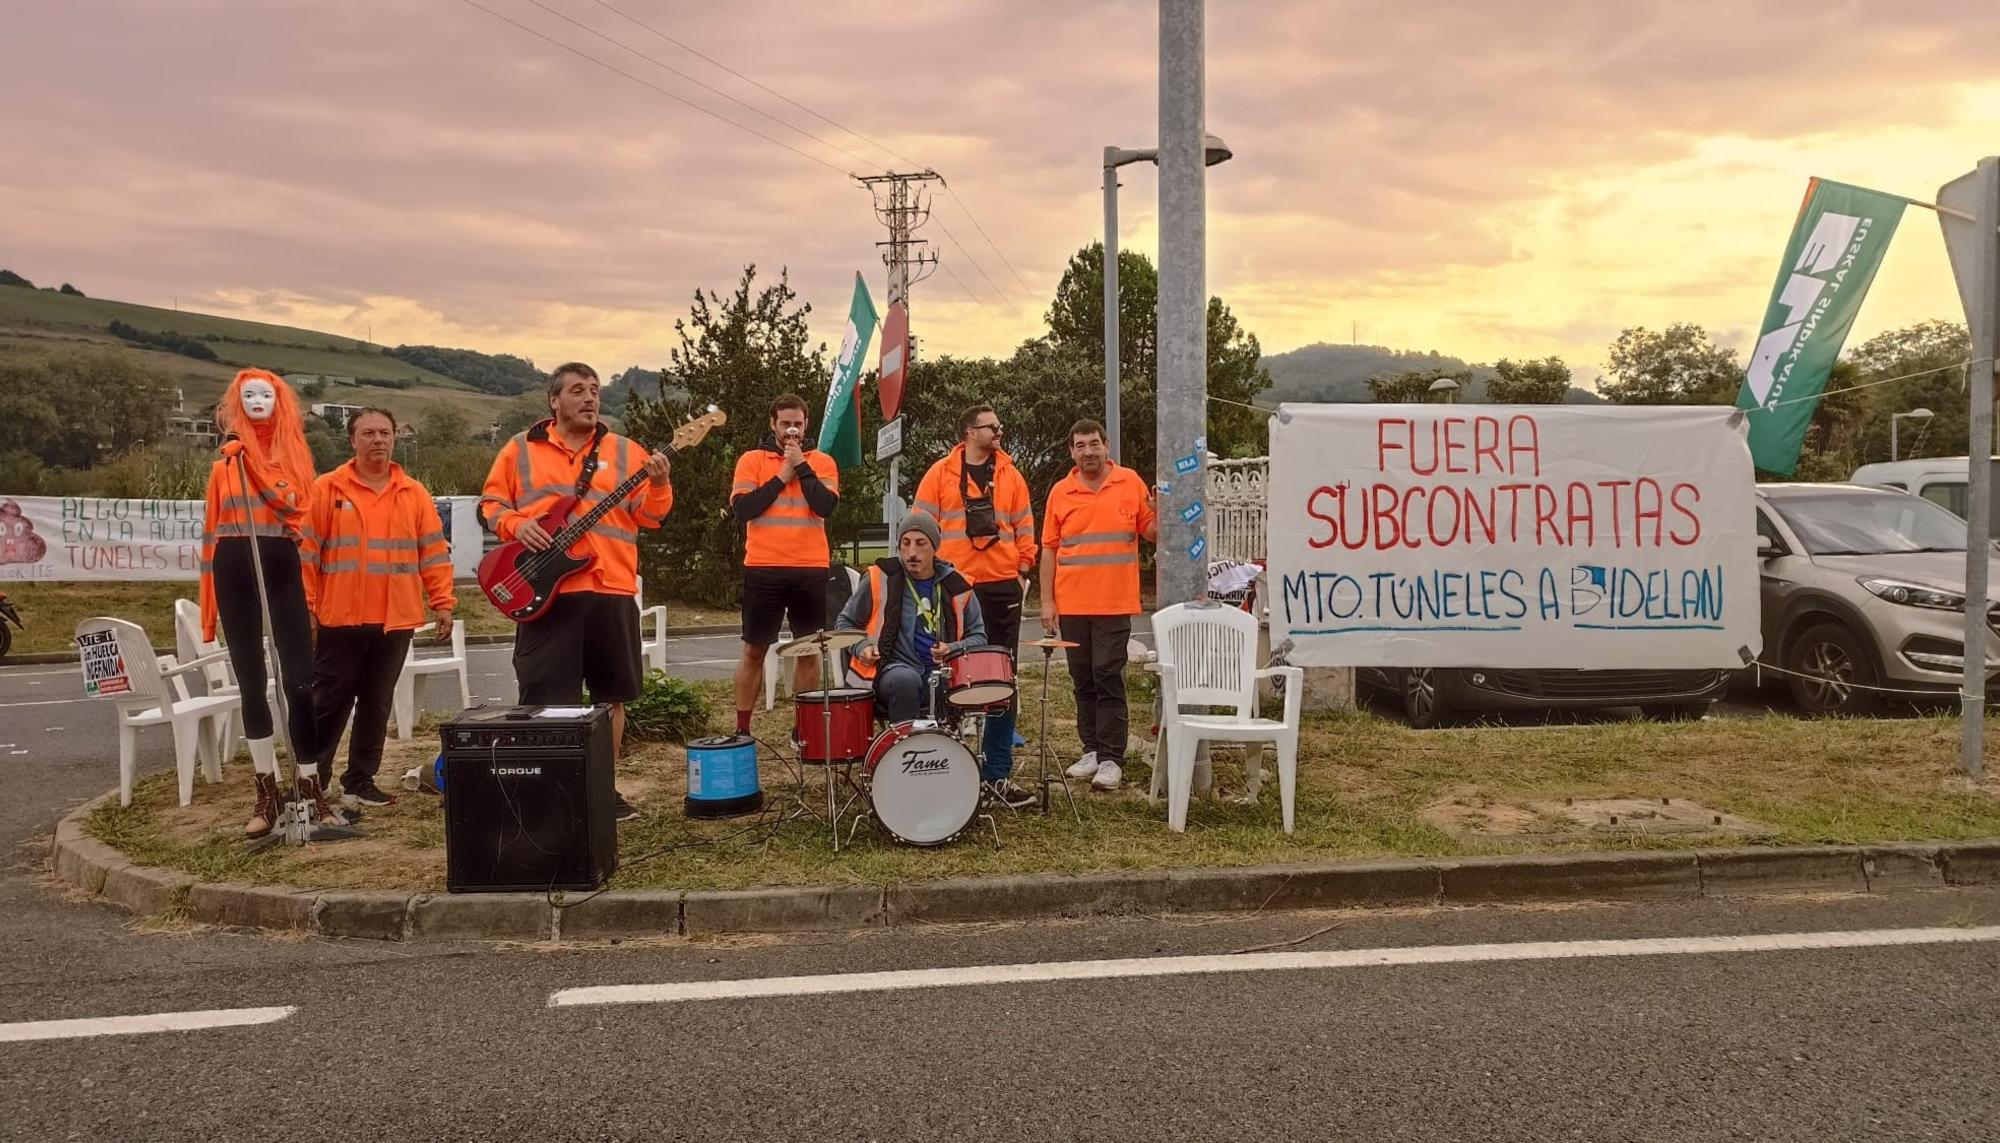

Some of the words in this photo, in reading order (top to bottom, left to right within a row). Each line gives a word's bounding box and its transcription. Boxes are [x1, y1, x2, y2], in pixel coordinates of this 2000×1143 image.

[1378, 415, 1539, 477] FUERA
[62, 499, 130, 520] ALGO
[141, 500, 206, 521] HUEL
[1307, 477, 1701, 550] SUBCONTRATAS
[62, 520, 95, 543] EN
[107, 521, 134, 541] LA
[64, 545, 168, 571] TÚNELES
[1539, 567, 1561, 620] A
[489, 767, 542, 776] TORQUE
[902, 749, 949, 774] Fame
